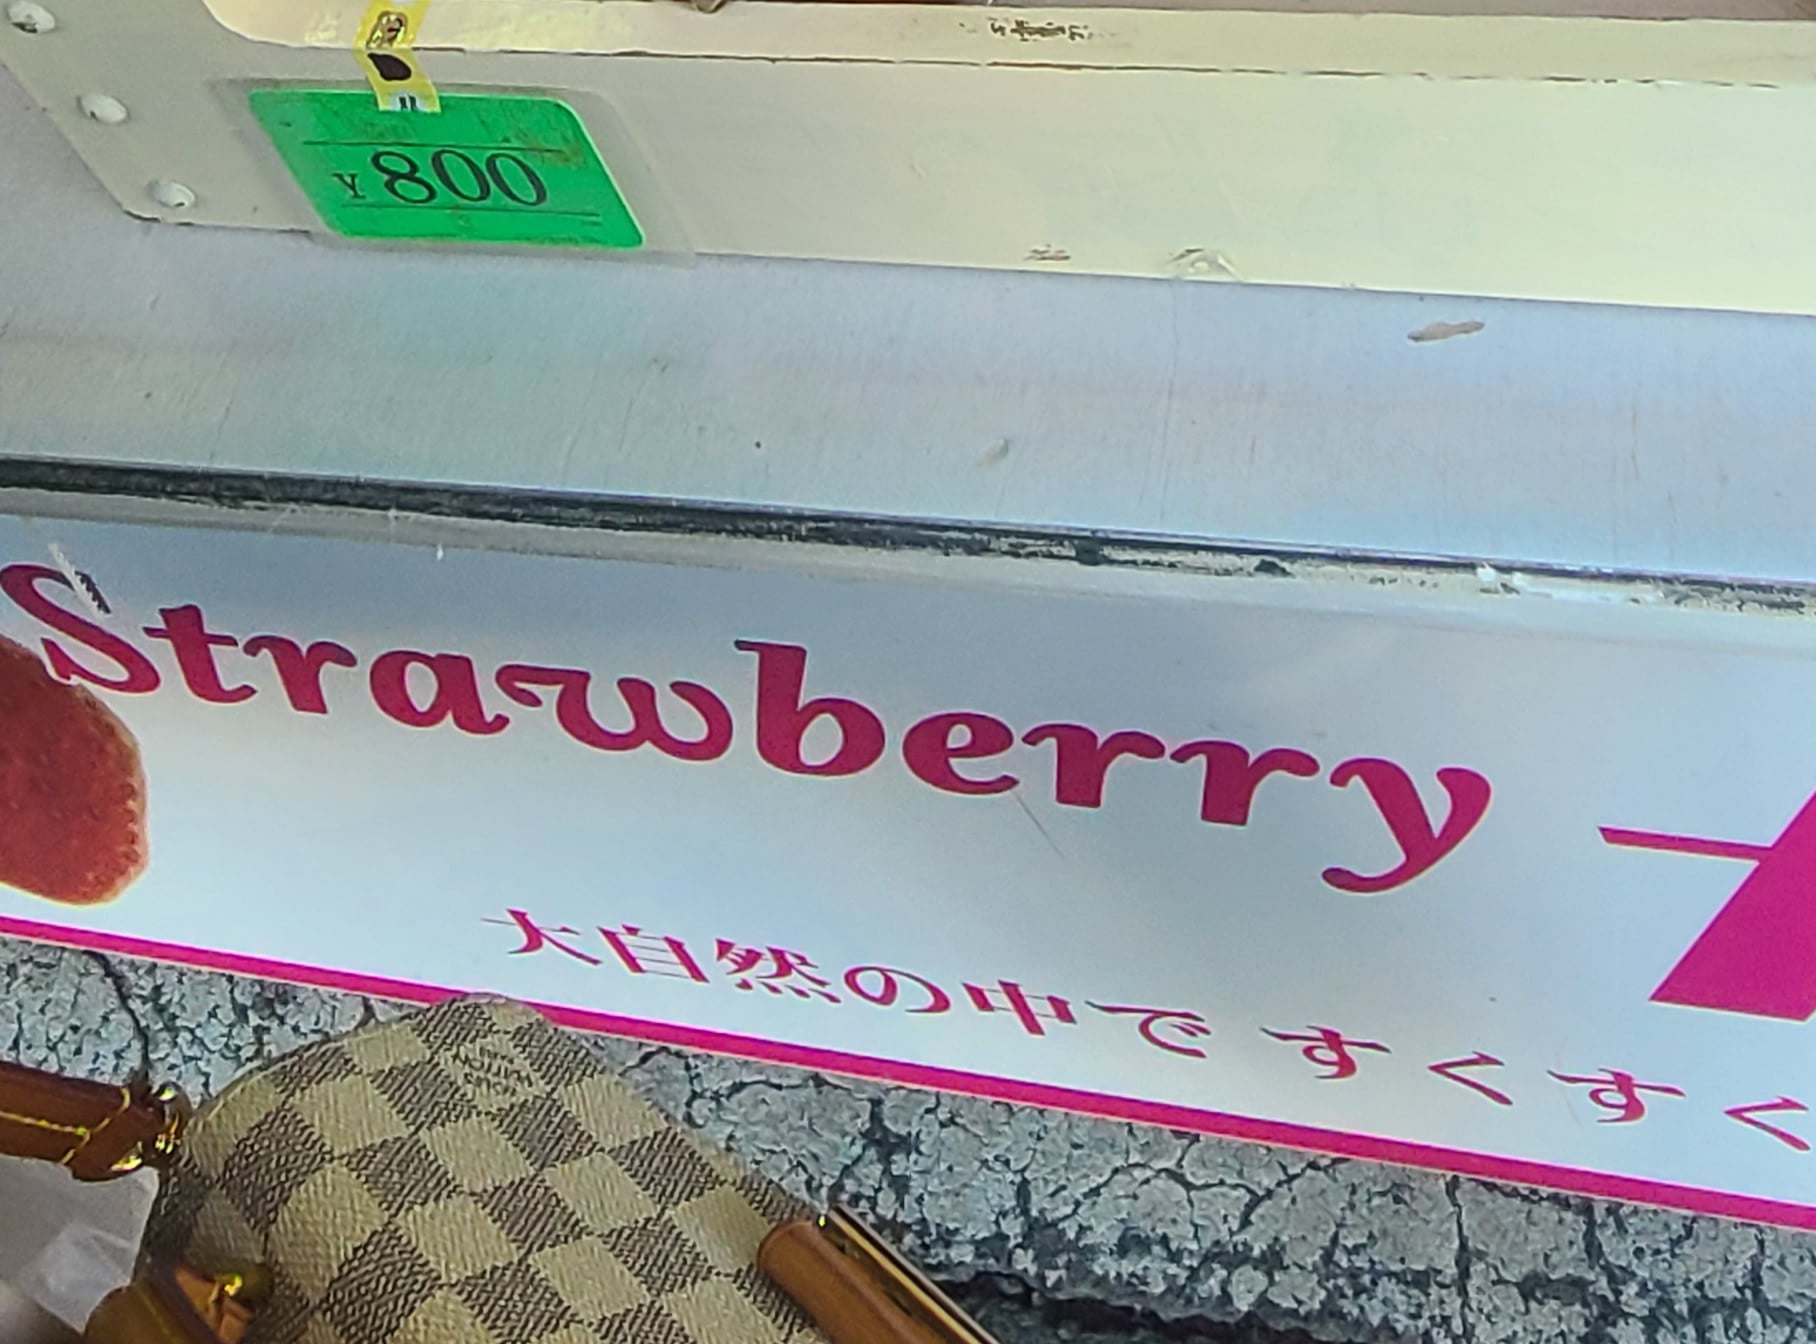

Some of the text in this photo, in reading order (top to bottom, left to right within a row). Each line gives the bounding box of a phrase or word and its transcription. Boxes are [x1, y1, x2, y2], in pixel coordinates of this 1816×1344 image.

[0, 563, 1493, 894] Strawberry
[481, 908, 1813, 1154] 大自然の中で すくすく
